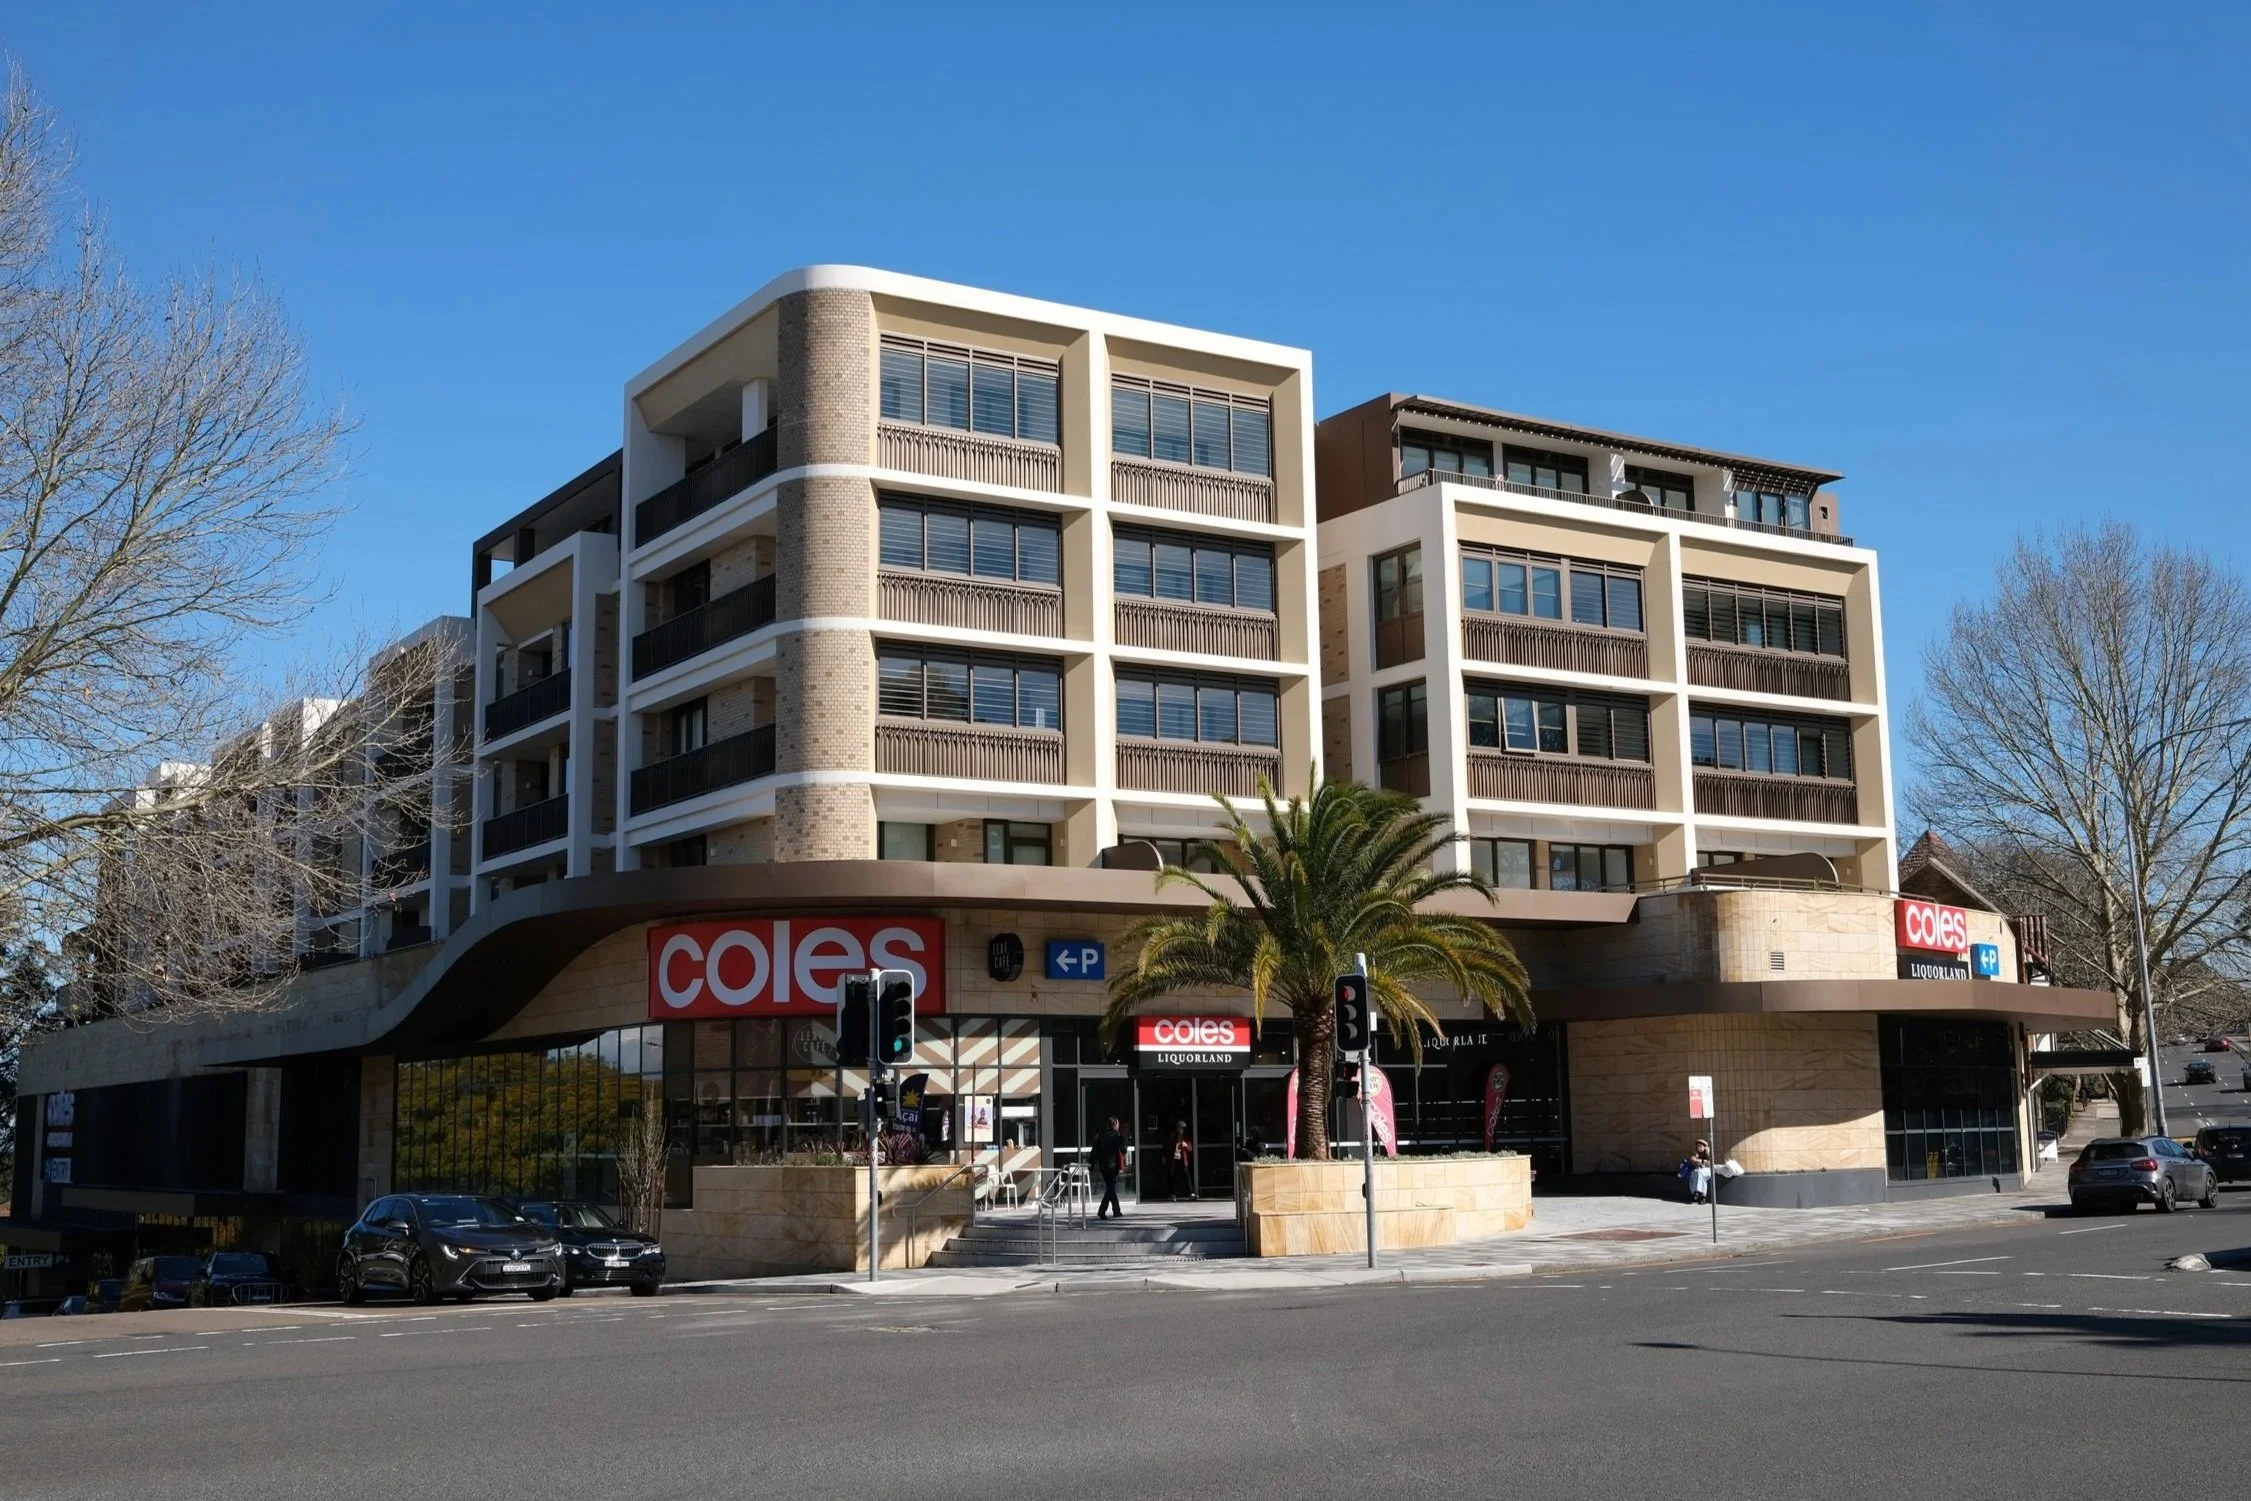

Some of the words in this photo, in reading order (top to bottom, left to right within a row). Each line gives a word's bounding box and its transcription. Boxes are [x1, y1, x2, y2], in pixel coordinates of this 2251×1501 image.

[1906, 905, 1966, 950] coles
[658, 920, 927, 1009] coles
[1081, 948, 1099, 974] P
[1911, 963, 1967, 979] LIQUORLAND
[1989, 949, 1997, 971] P
[1154, 1017, 1235, 1045] coles
[1158, 1053, 1232, 1065] LIQUORLAND
[53, 1161, 69, 1179] ENTRY
[9, 1256, 49, 1266] ENTRY
